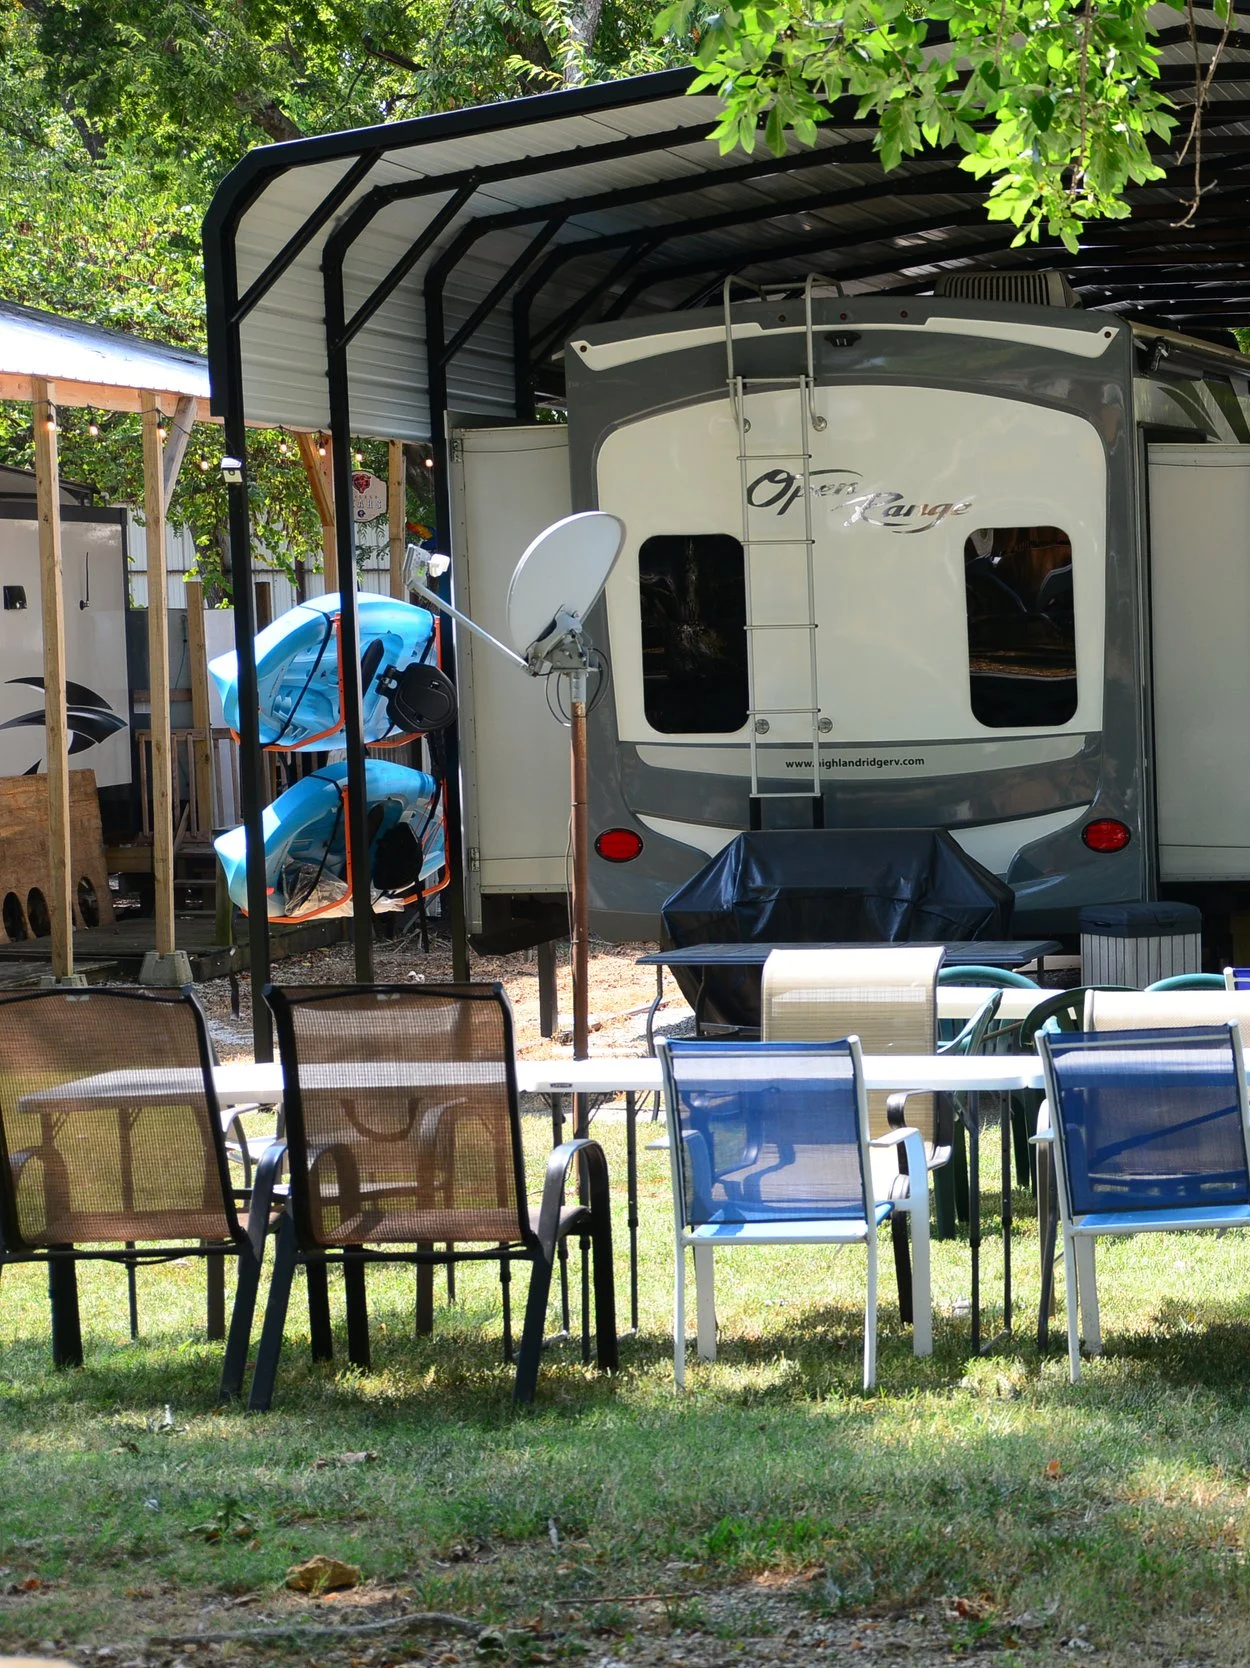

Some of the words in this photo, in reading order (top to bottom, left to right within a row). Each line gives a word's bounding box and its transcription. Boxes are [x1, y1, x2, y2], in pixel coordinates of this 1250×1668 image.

[747, 469, 861, 516] Open
[831, 491, 973, 534] Range
[785, 757, 925, 770] www.ighlandridgerv.com
